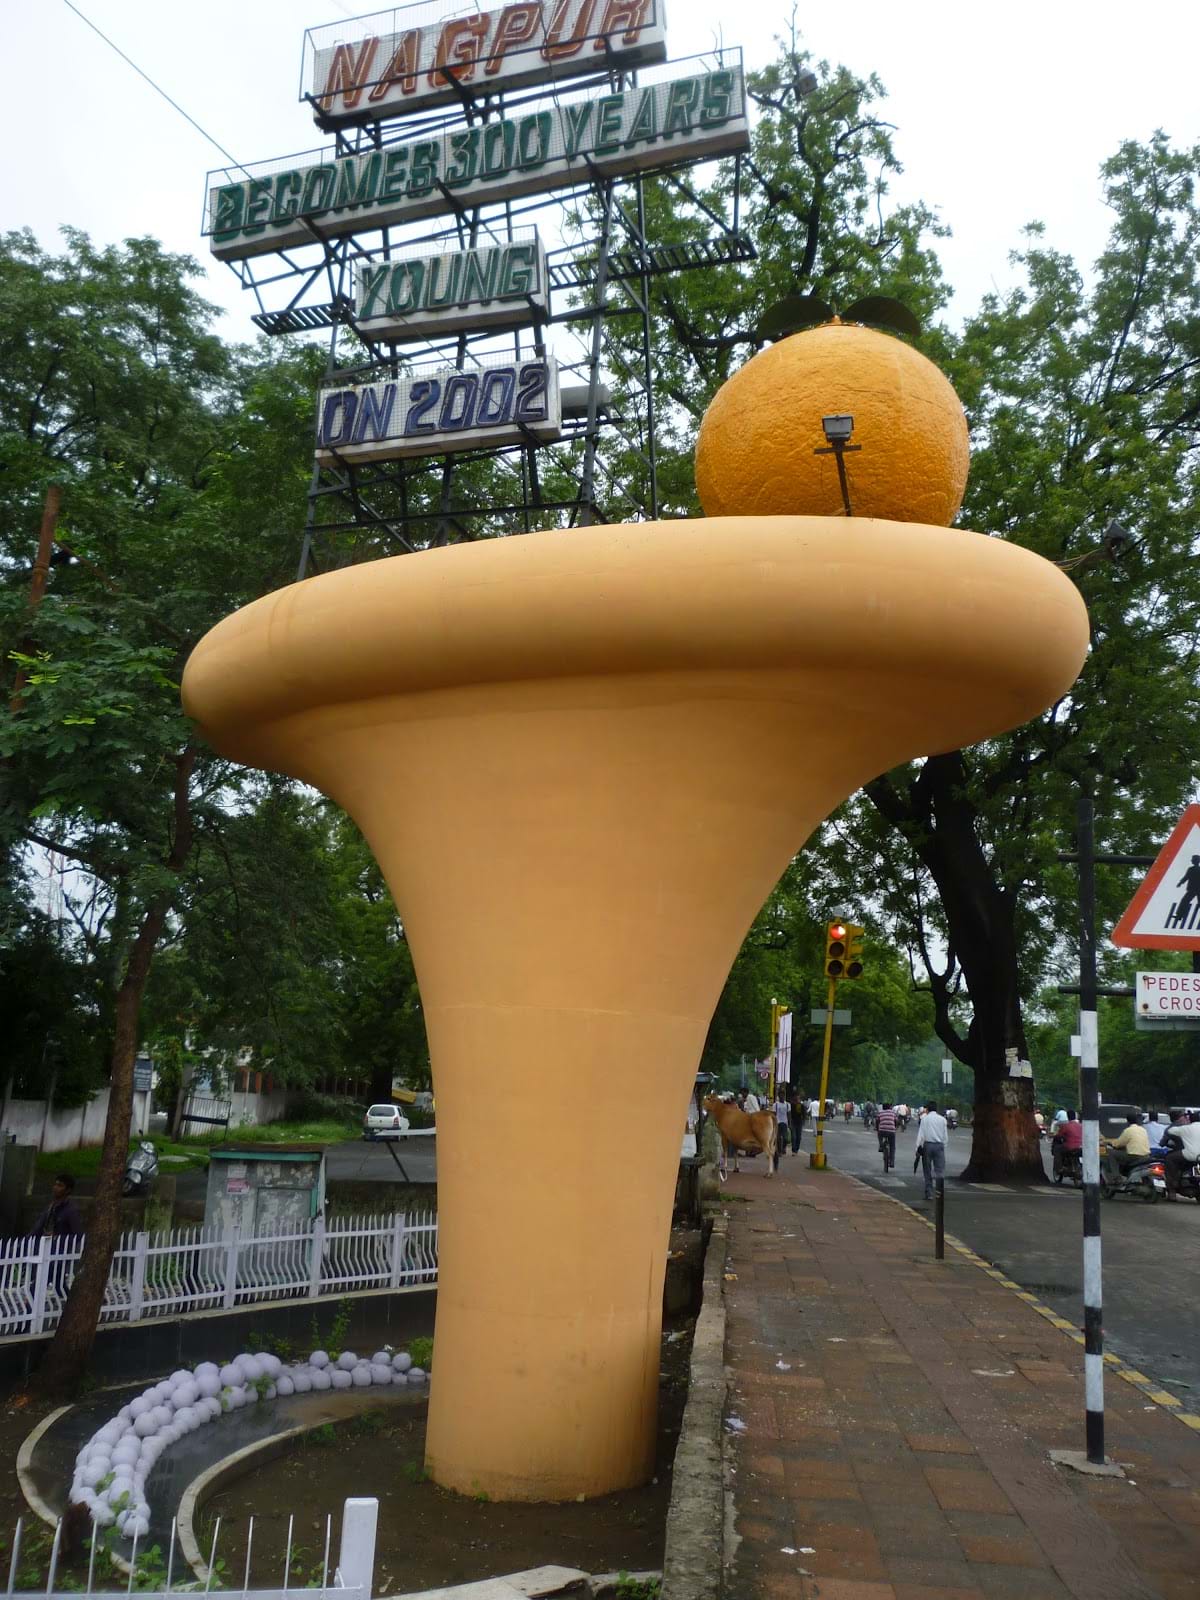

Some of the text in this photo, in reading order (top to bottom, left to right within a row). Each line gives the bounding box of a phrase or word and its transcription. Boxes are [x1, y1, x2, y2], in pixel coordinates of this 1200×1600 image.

[320, 0, 650, 111] NAGPUR
[213, 70, 736, 243] BECOMES 300 YEARS
[358, 244, 536, 320] YOUNG
[320, 362, 549, 446] ON 2002
